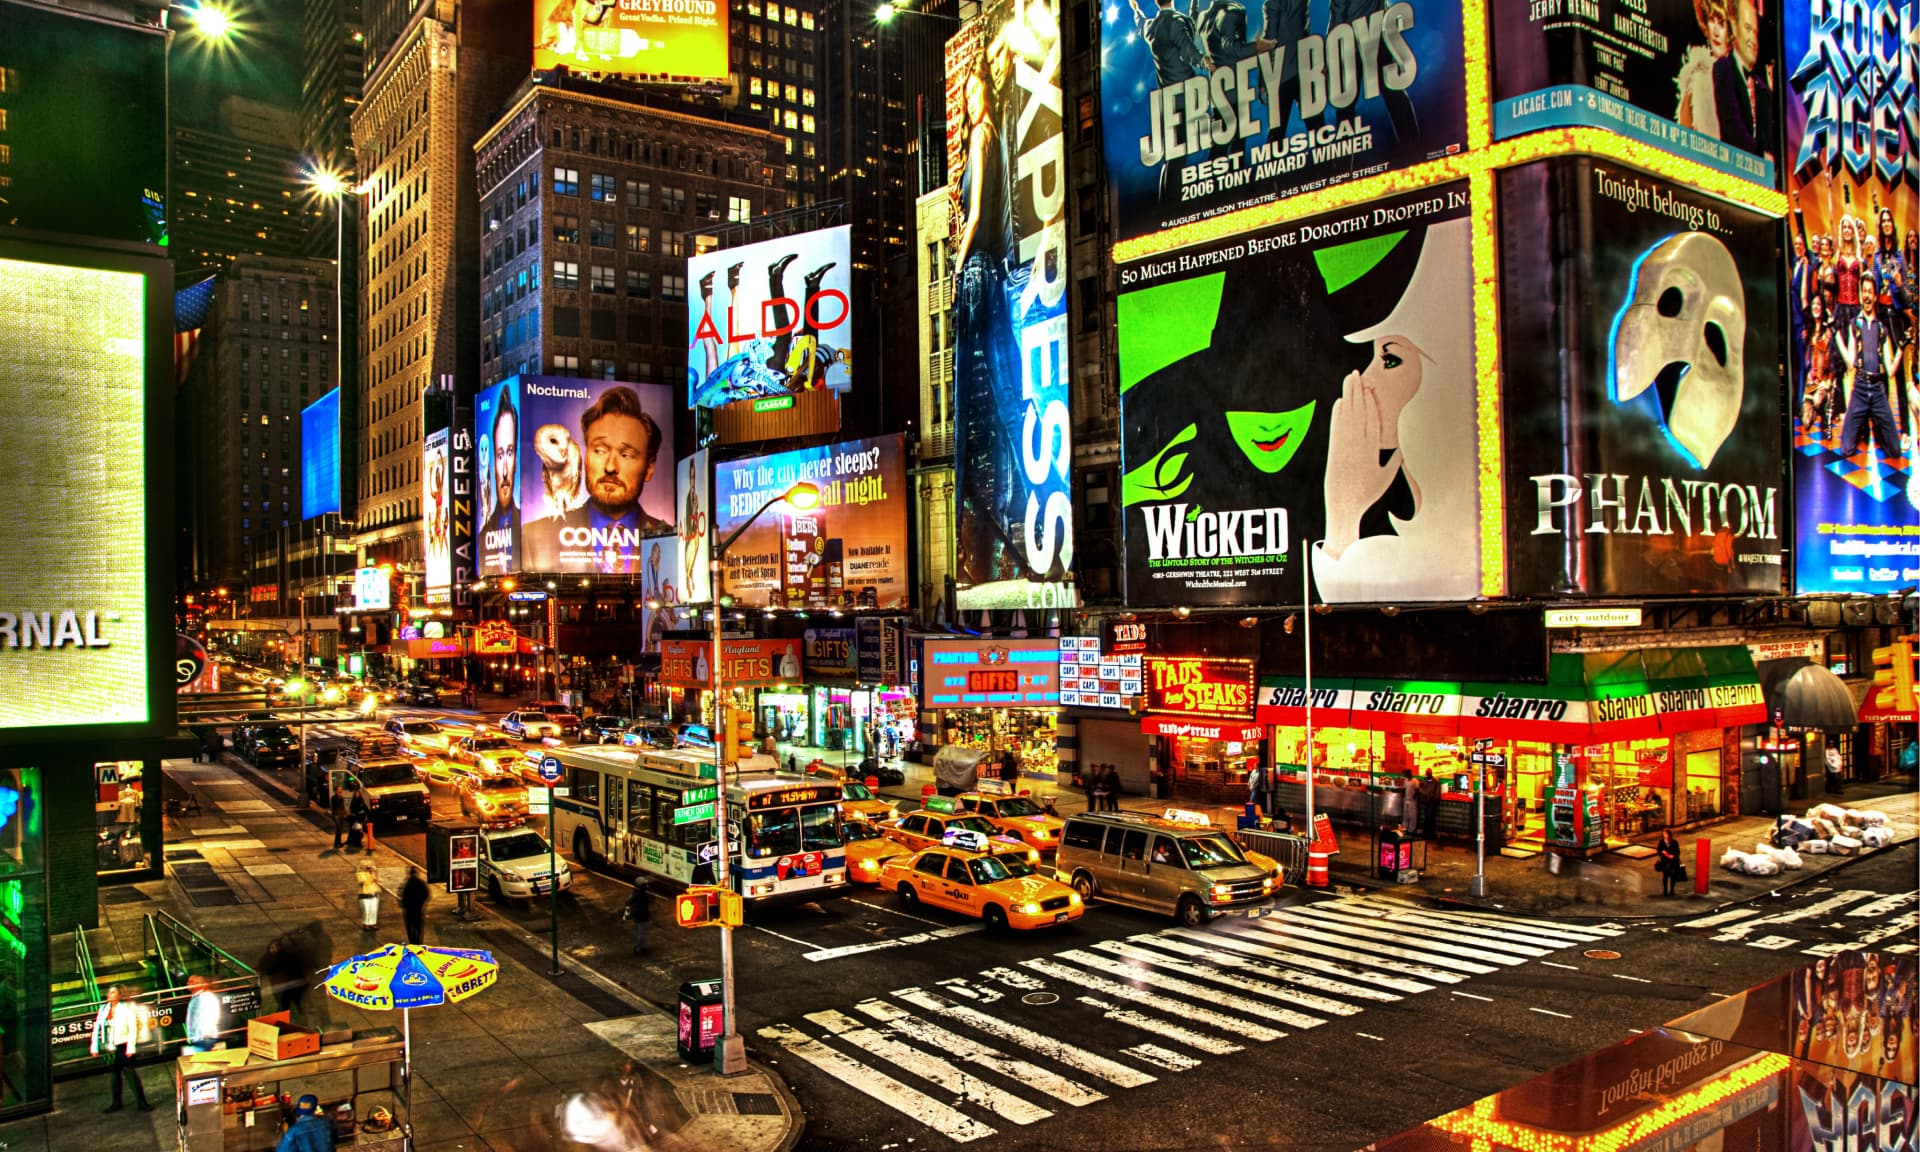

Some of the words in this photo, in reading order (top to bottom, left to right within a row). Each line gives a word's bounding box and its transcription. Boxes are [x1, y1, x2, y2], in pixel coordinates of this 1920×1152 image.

[619, 0, 716, 15] GREYHOUND
[1529, 0, 1561, 21] JERRY
[619, 12, 640, 22] Great
[668, 15, 692, 25] Priced
[694, 16, 718, 27] Right.
[1140, 46, 1285, 167] JERSEY
[1298, 3, 1418, 120] BOYS
[1512, 90, 1572, 119] LACAGE.COM
[1181, 152, 1243, 185] BEST
[1251, 116, 1371, 165] MUSICAL
[1181, 179, 1214, 202] 2006
[1218, 169, 1251, 191] TONY
[1255, 155, 1307, 182] AWARD
[1313, 134, 1372, 165] WINNER
[1168, 212, 1200, 228] AUGUST
[1203, 203, 1235, 219] WILSON
[1237, 193, 1279, 209] THEATRE,
[1280, 186, 1299, 198] 245
[1301, 178, 1326, 192] WEST
[1352, 162, 1390, 179] STREET
[1594, 168, 1650, 213] Tonight
[1652, 182, 1705, 231] belongs
[1122, 270, 1138, 286] SO
[1141, 259, 1176, 280] MUCH
[1179, 245, 1245, 274] HAPPENED
[1247, 232, 1297, 256] BEFORE
[1300, 217, 1369, 244] DOROTHY
[1373, 201, 1443, 227] DROPPED
[689, 289, 849, 349] ALDO
[527, 383, 591, 399] Nocturnal.
[733, 468, 755, 491] Why
[757, 464, 774, 485] the
[799, 456, 832, 481] never
[835, 446, 880, 475] sleeps?
[823, 480, 841, 506] all
[845, 474, 888, 506] night.
[1529, 472, 1778, 540] PHANTOM
[559, 526, 640, 547] CONAN
[678, 511, 706, 542] ALDO
[1140, 503, 1289, 560] WICKED
[485, 528, 512, 550] CONAN
[743, 554, 769, 566] Detection
[742, 567, 760, 579] Travel
[1166, 570, 1194, 578] GERSHWIN
[1234, 569, 1249, 577] WEST
[1262, 567, 1284, 576] STREET
[1559, 614, 1580, 623] city
[1585, 613, 1630, 622] outdoor
[814, 640, 849, 659] GIFTS
[1062, 639, 1075, 648] CAPS
[663, 658, 693, 678] GIFTS
[717, 658, 770, 679] GIFTS
[1082, 653, 1095, 662] CAPS
[1123, 655, 1137, 664] CAPS
[970, 670, 1016, 691] GIFTS
[1063, 667, 1075, 675] CAPS
[1102, 668, 1115, 677] CAPS
[1083, 681, 1096, 690] CAPS
[1124, 682, 1137, 691] CAPS
[1183, 682, 1248, 710] STEAKS
[1063, 694, 1075, 702] CAPS
[1103, 696, 1117, 705] CAPS
[1270, 684, 1338, 709] sbarro
[1366, 687, 1445, 714] sbarro
[1475, 692, 1568, 721] sbarro
[1599, 693, 1648, 722] sbarro
[1660, 688, 1706, 713] sbarro
[1715, 682, 1757, 708] sbarro
[1190, 725, 1221, 738] STEAKS
[1241, 726, 1262, 741] TAD'S
[690, 790, 697, 800] W
[697, 788, 708, 799] 47
[675, 807, 695, 818] FATHER
[696, 804, 713, 815] DUFFY
[704, 845, 716, 857] ONE
[447, 969, 496, 998] SABRETT
[330, 985, 389, 1006] SABRETT
[51, 1024, 68, 1036] 49
[70, 1022, 82, 1033] St
